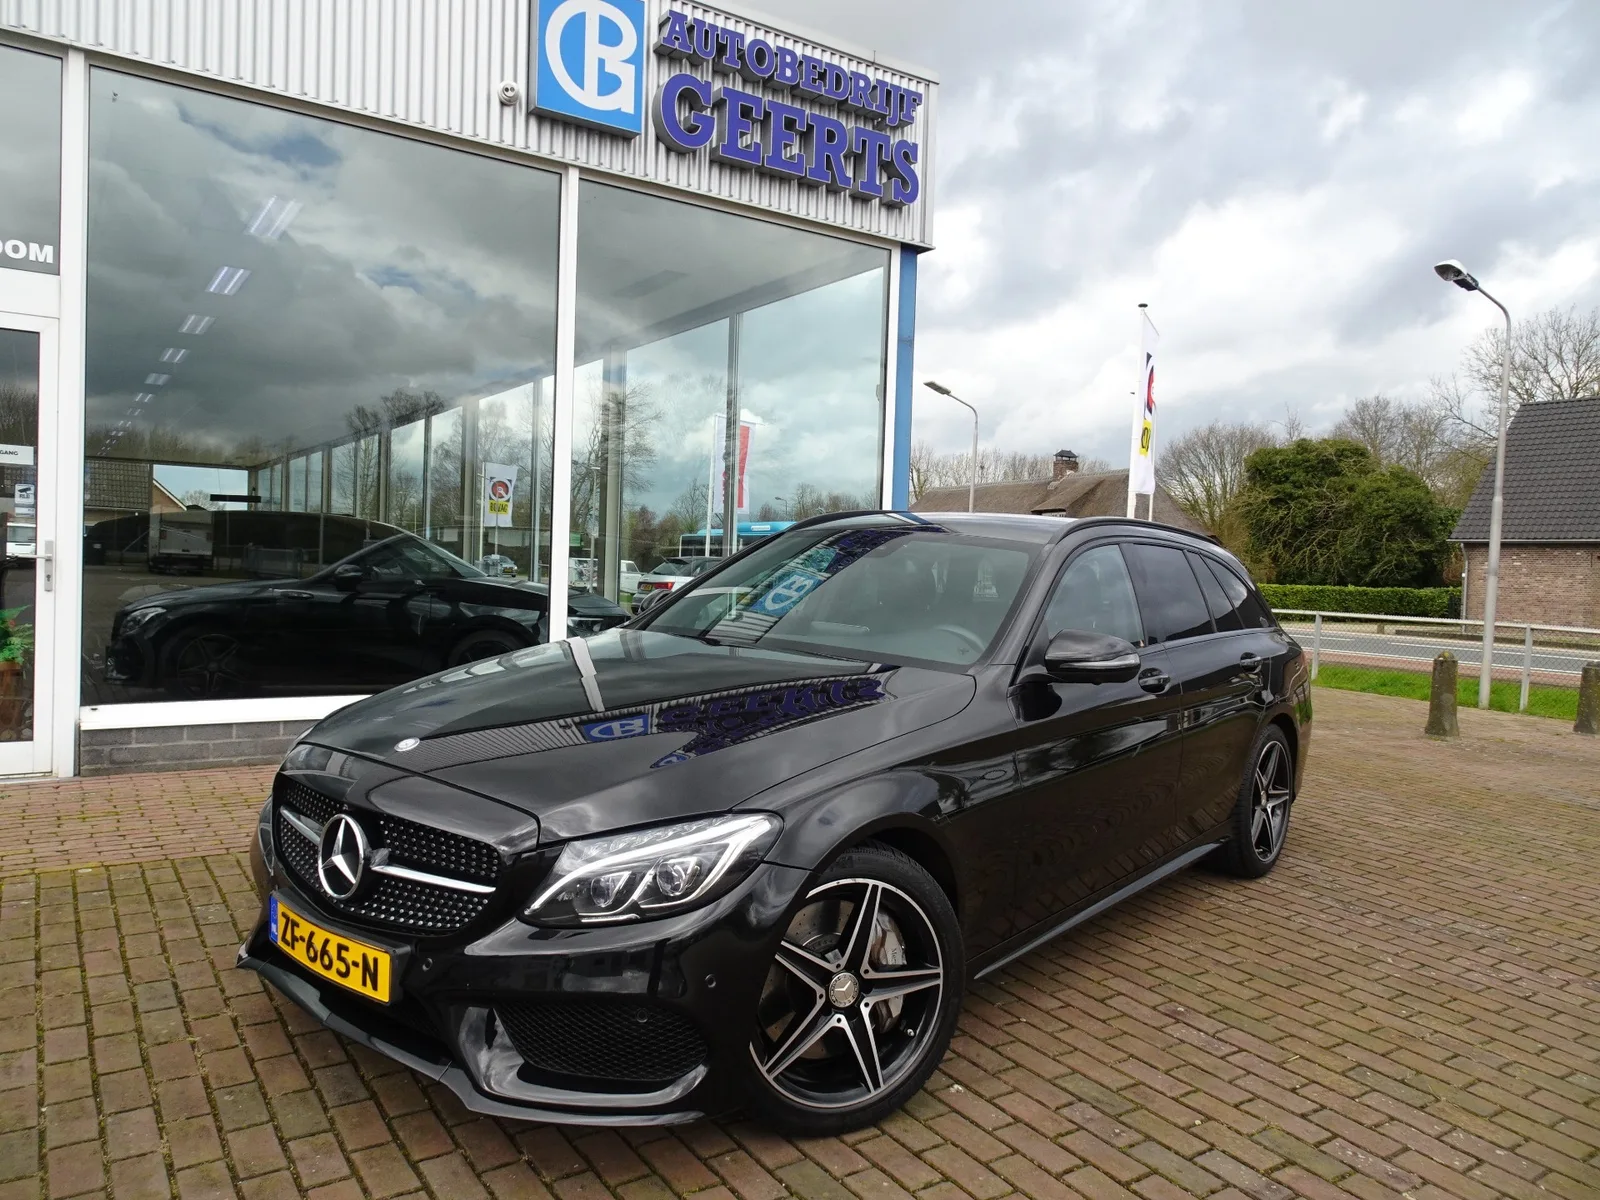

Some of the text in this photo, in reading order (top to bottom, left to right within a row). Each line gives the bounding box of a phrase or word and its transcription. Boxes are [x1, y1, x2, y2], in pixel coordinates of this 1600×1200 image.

[661, 9, 923, 128] AUTOBEDRIJF
[660, 72, 919, 206] GEERTS
[0, 239, 54, 264] OM
[281, 911, 379, 992] ZF-665-N
